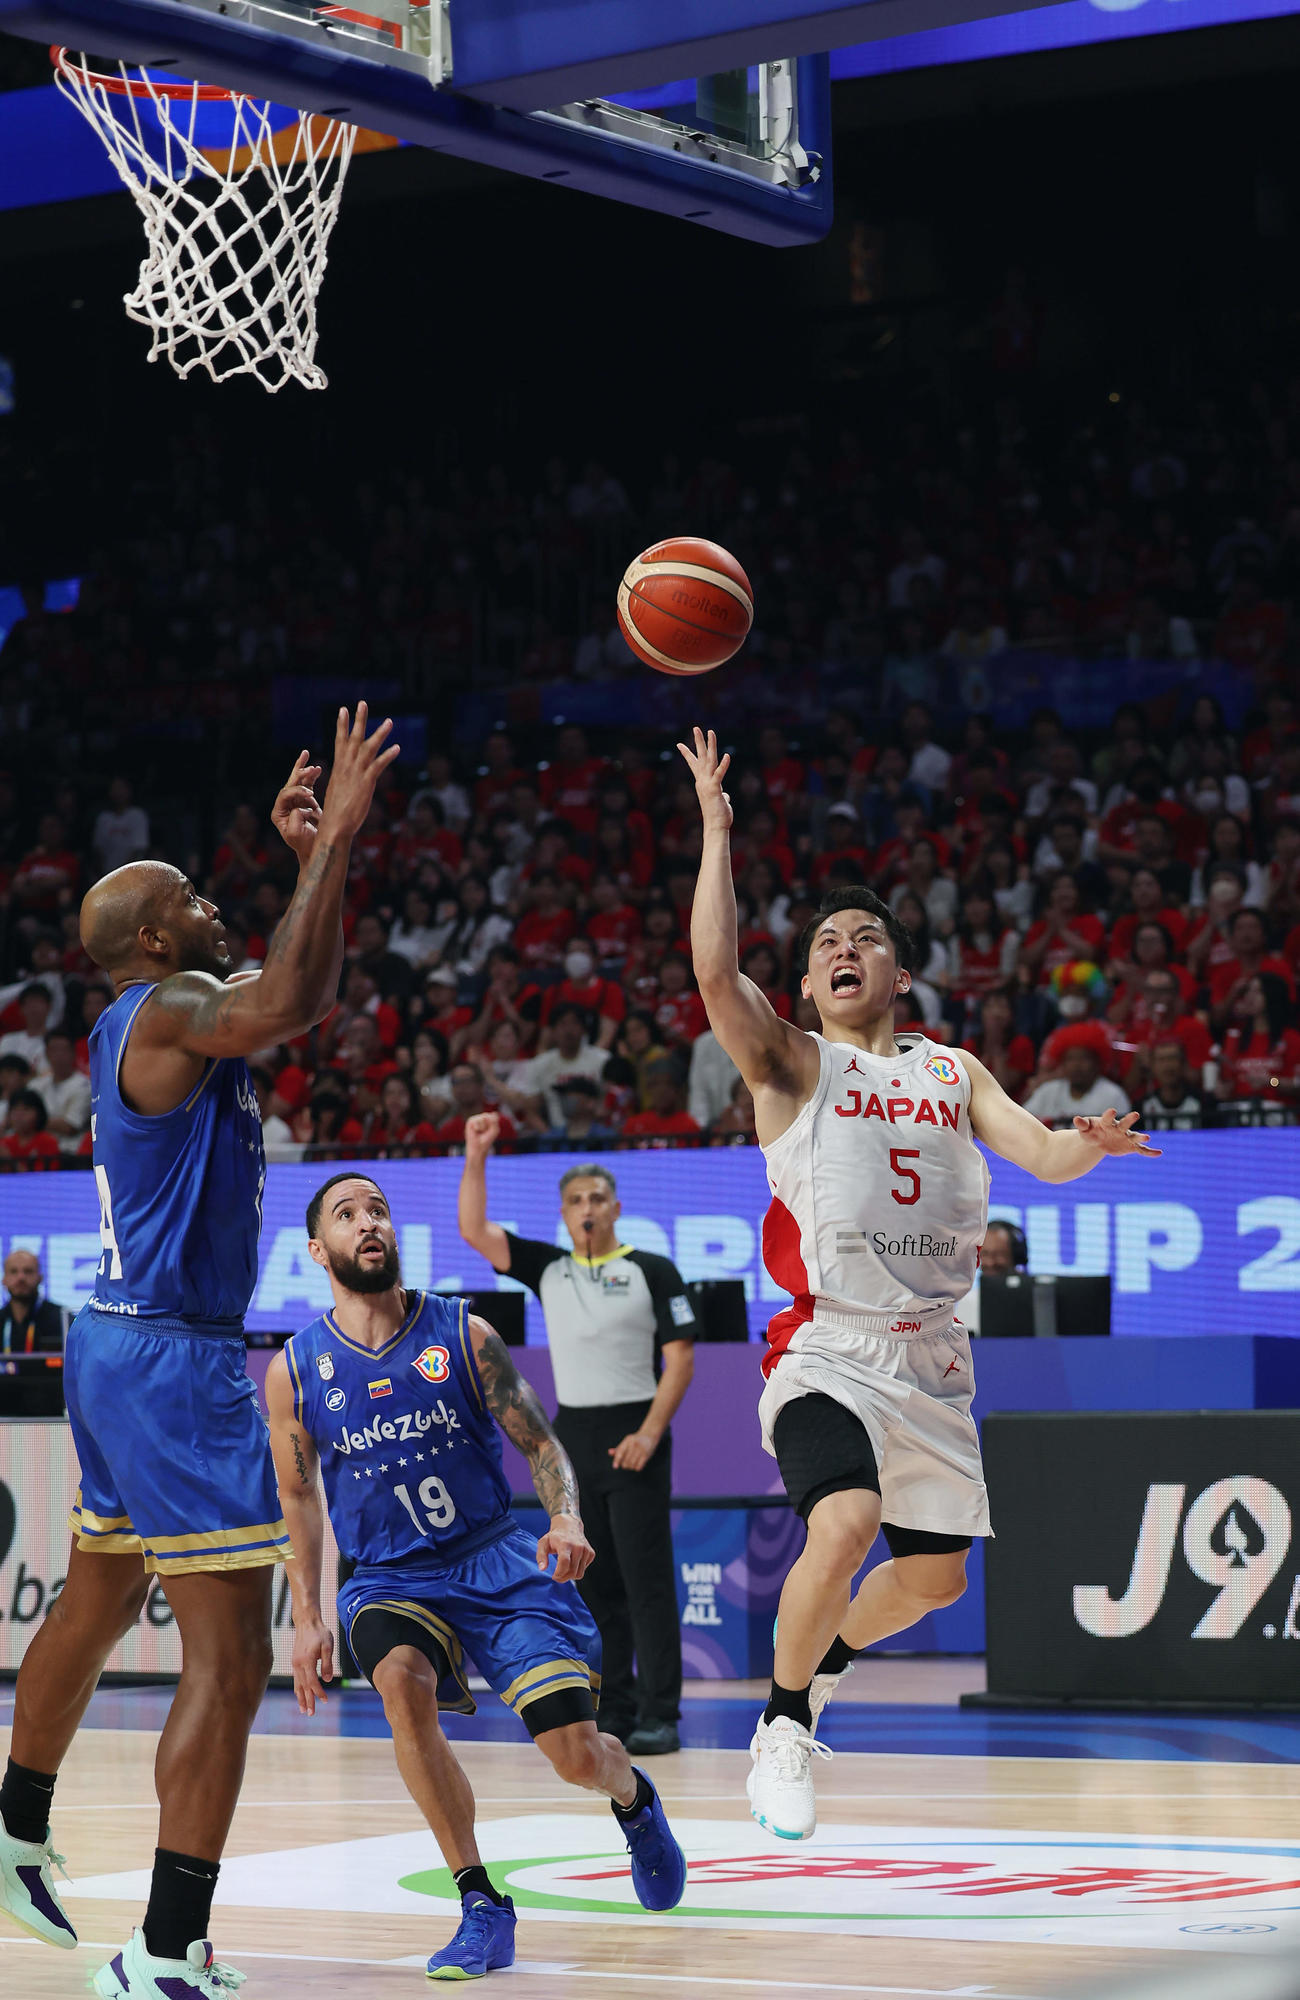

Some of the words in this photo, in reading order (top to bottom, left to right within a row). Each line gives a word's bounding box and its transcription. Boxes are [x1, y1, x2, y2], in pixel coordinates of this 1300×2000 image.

[671, 590, 729, 621] molten
[834, 1089, 961, 1132] JAPAN
[889, 1147, 921, 1206] 5
[872, 1231, 958, 1257] SoftBank
[890, 1320, 922, 1335] JPN
[393, 1475, 457, 1537] 19
[681, 1603, 723, 1626] ALL
